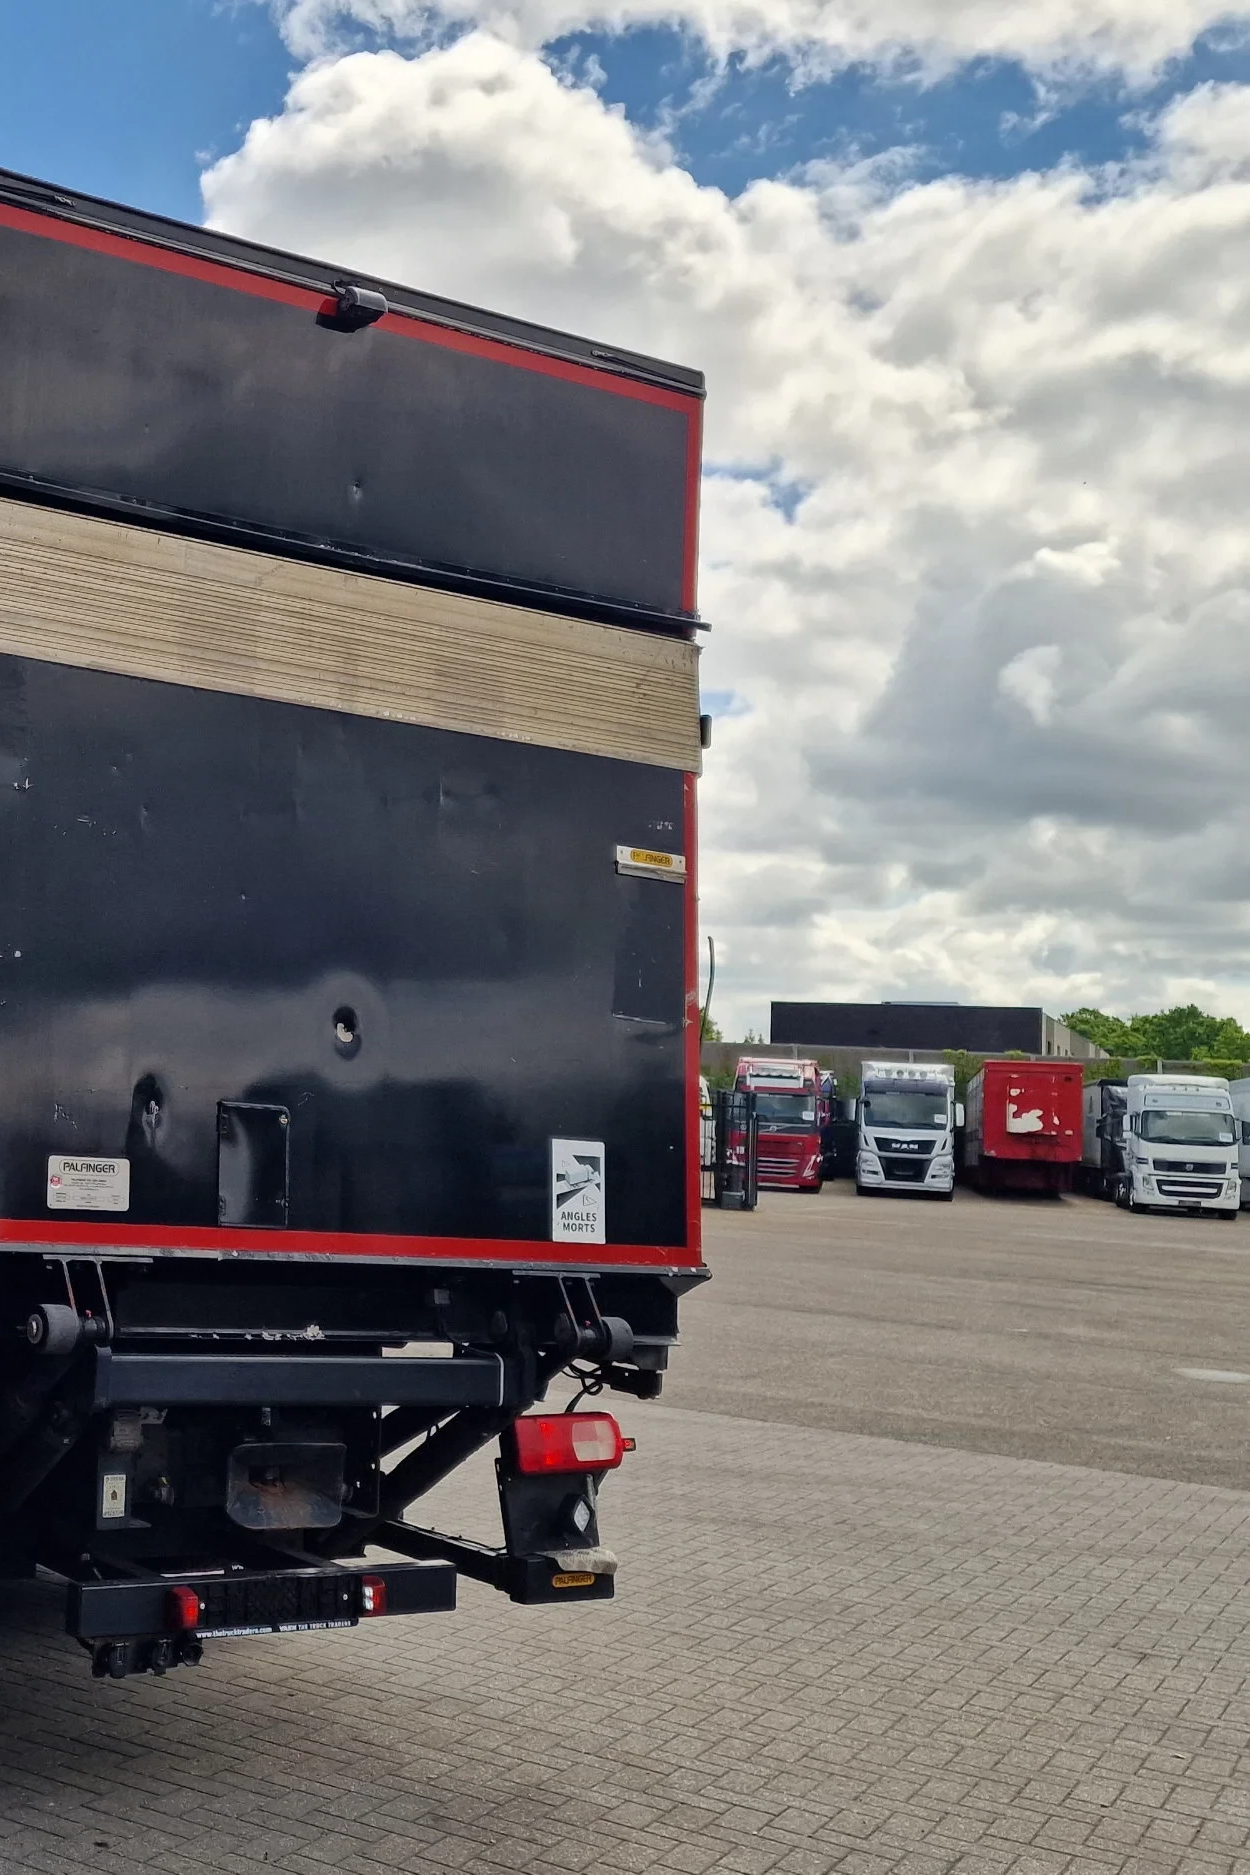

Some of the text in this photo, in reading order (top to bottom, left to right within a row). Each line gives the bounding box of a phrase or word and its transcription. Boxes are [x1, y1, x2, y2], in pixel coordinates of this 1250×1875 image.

[632, 851, 671, 866] PFINGER
[891, 1142, 919, 1150] MAN
[63, 1161, 116, 1174] PALFINGER
[561, 1211, 597, 1222] ANGLES
[562, 1222, 596, 1233] MORTS
[554, 1574, 592, 1586] PALFINGER
